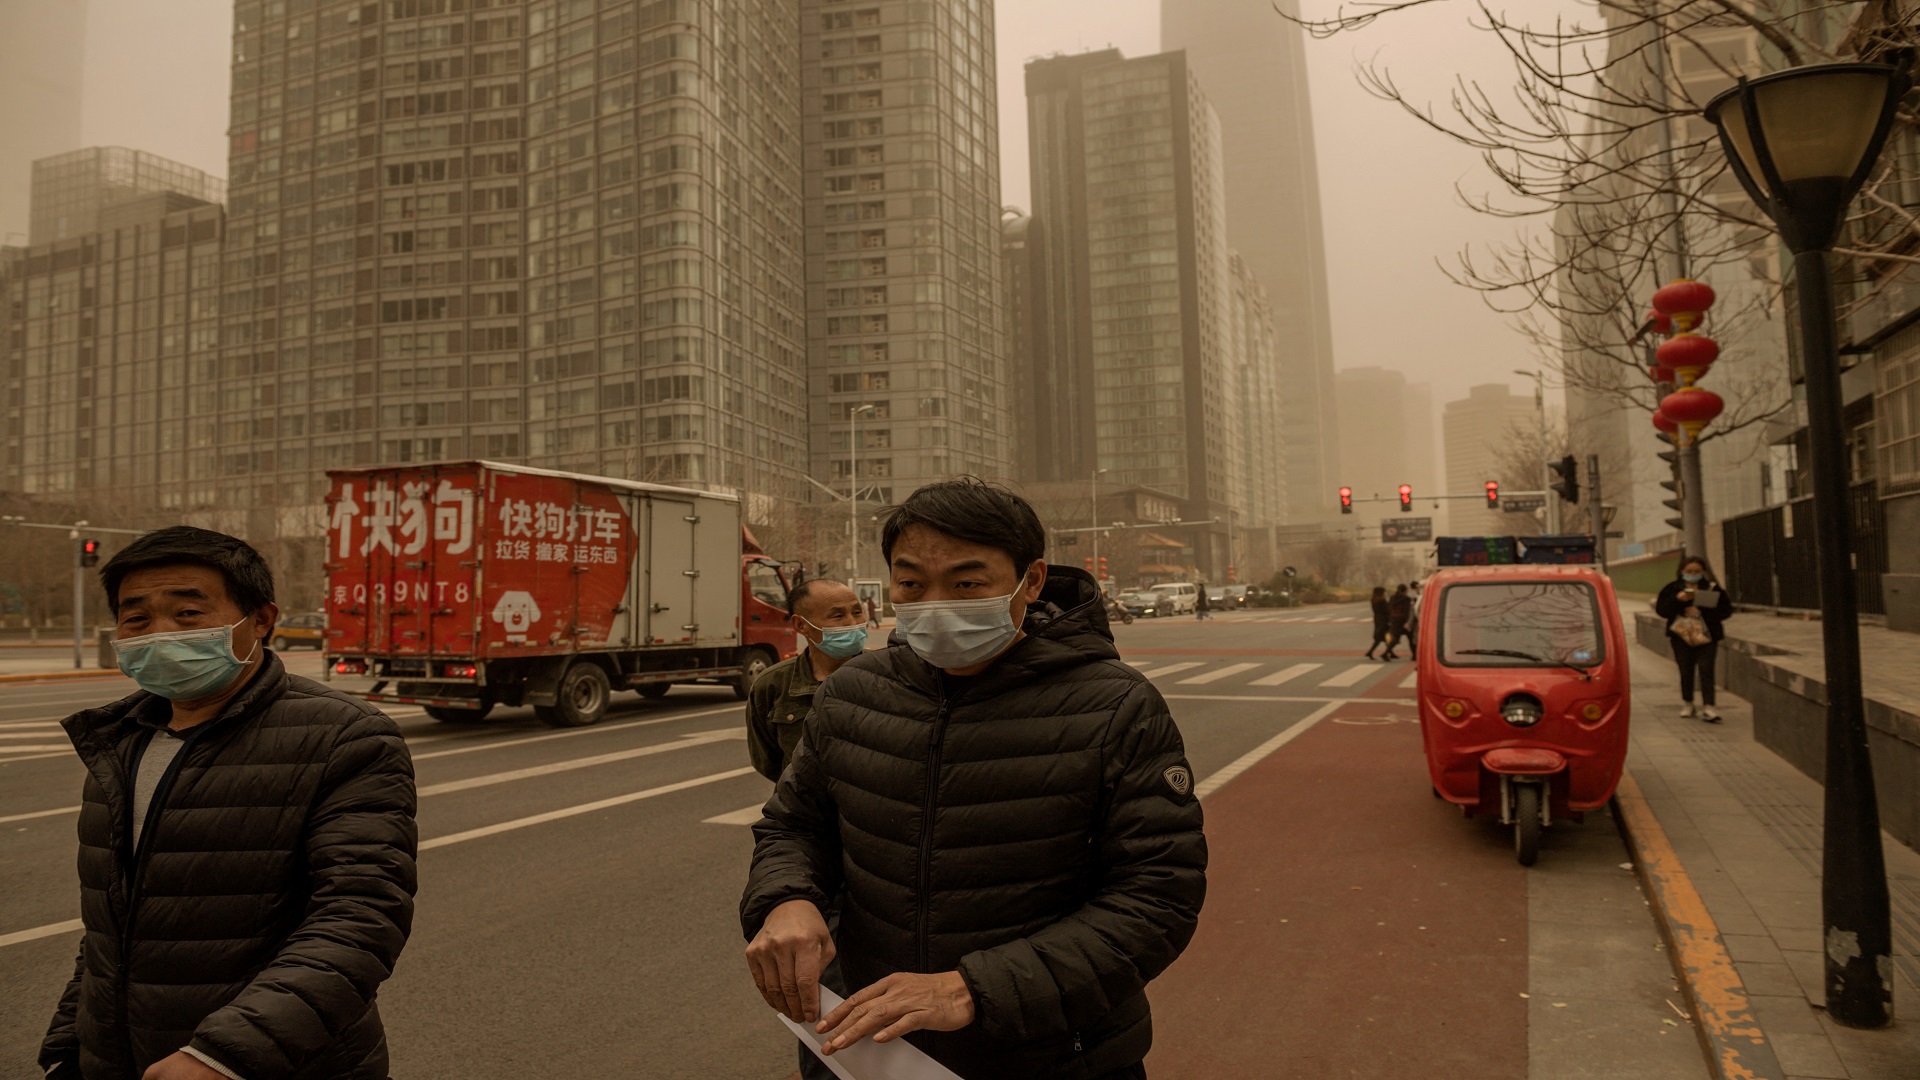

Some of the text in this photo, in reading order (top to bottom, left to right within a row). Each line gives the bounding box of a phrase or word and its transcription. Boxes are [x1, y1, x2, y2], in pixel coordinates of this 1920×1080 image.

[332, 479, 474, 558] 快狗
[499, 498, 620, 544] 快狗打车
[496, 539, 617, 564] 拉货 搬家 运东西
